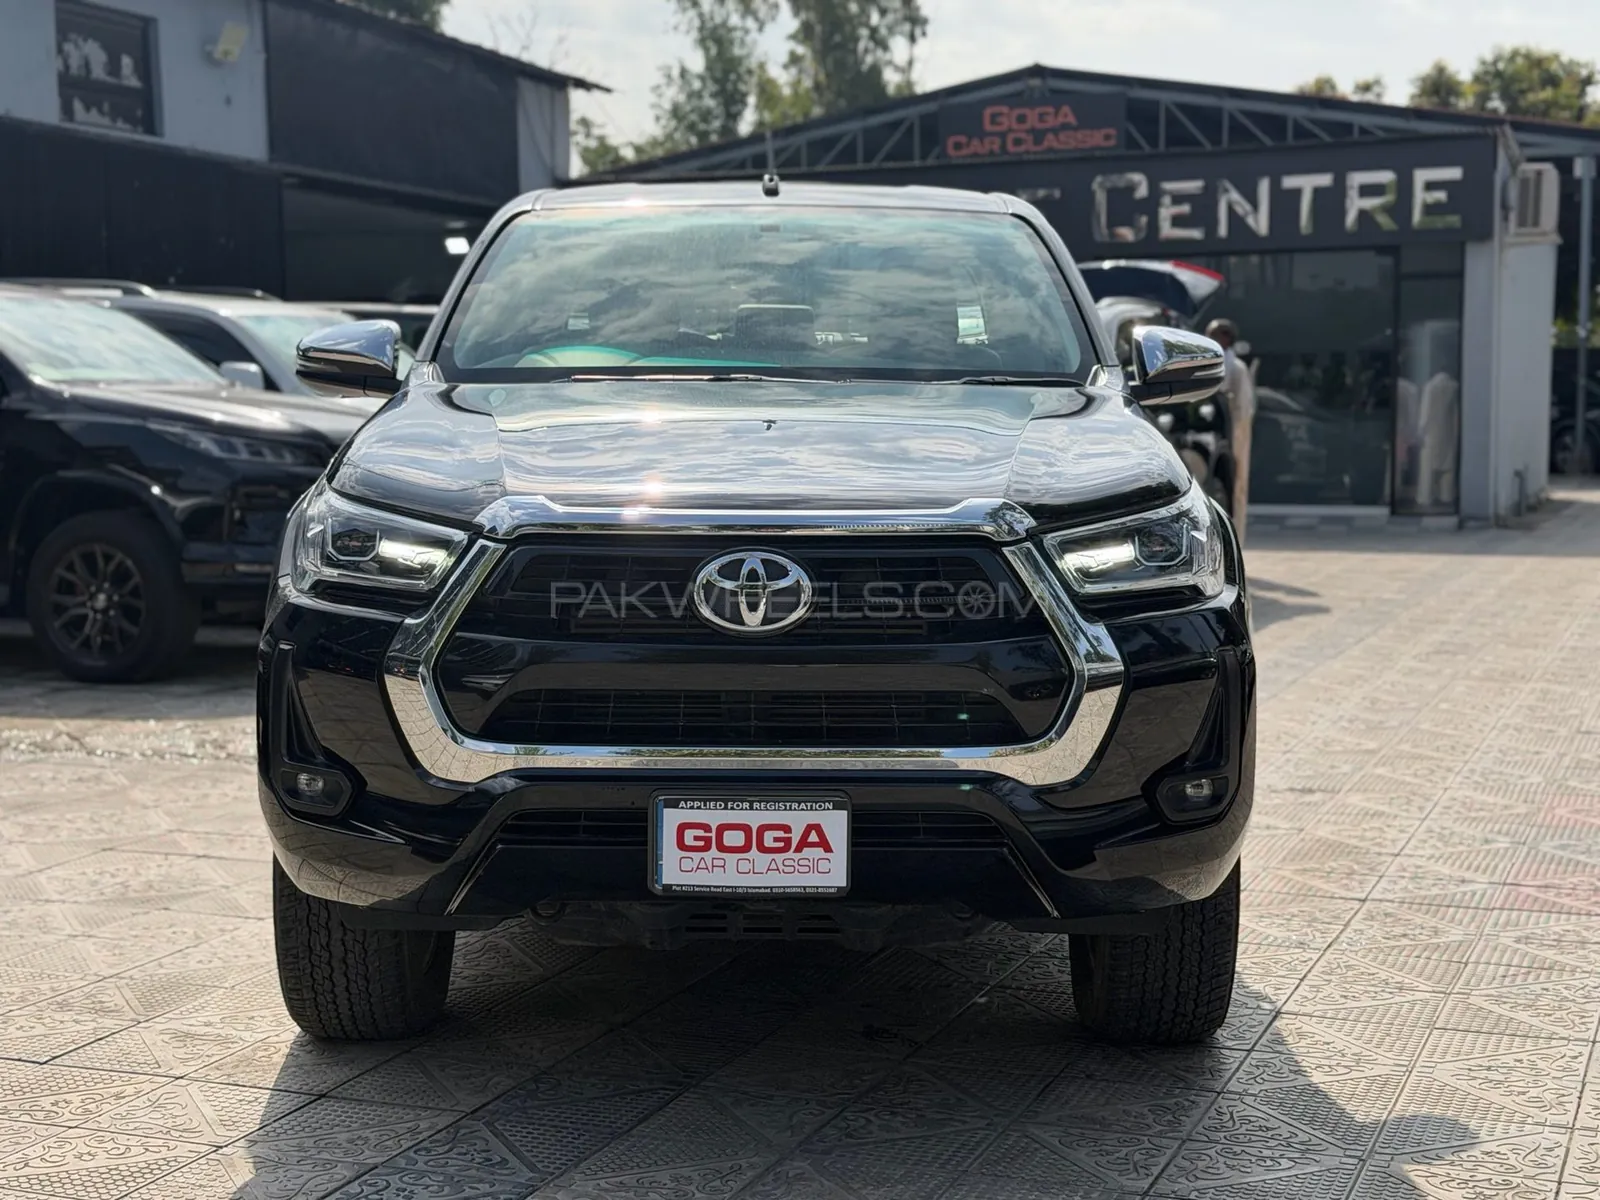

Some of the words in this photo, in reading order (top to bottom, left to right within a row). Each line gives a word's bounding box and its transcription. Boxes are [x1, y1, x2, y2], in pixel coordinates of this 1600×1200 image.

[982, 104, 1078, 132] GOGA
[946, 134, 1001, 157] CAR
[1006, 128, 1118, 152] CLASSIC
[1091, 166, 1464, 243] CENTRE
[678, 800, 725, 810] APPLIED
[727, 801, 750, 810] FOR
[752, 801, 834, 811] REGISTRATION
[676, 822, 834, 854] GOGA
[679, 856, 726, 874] CAR
[736, 857, 831, 875] CLASSIC
